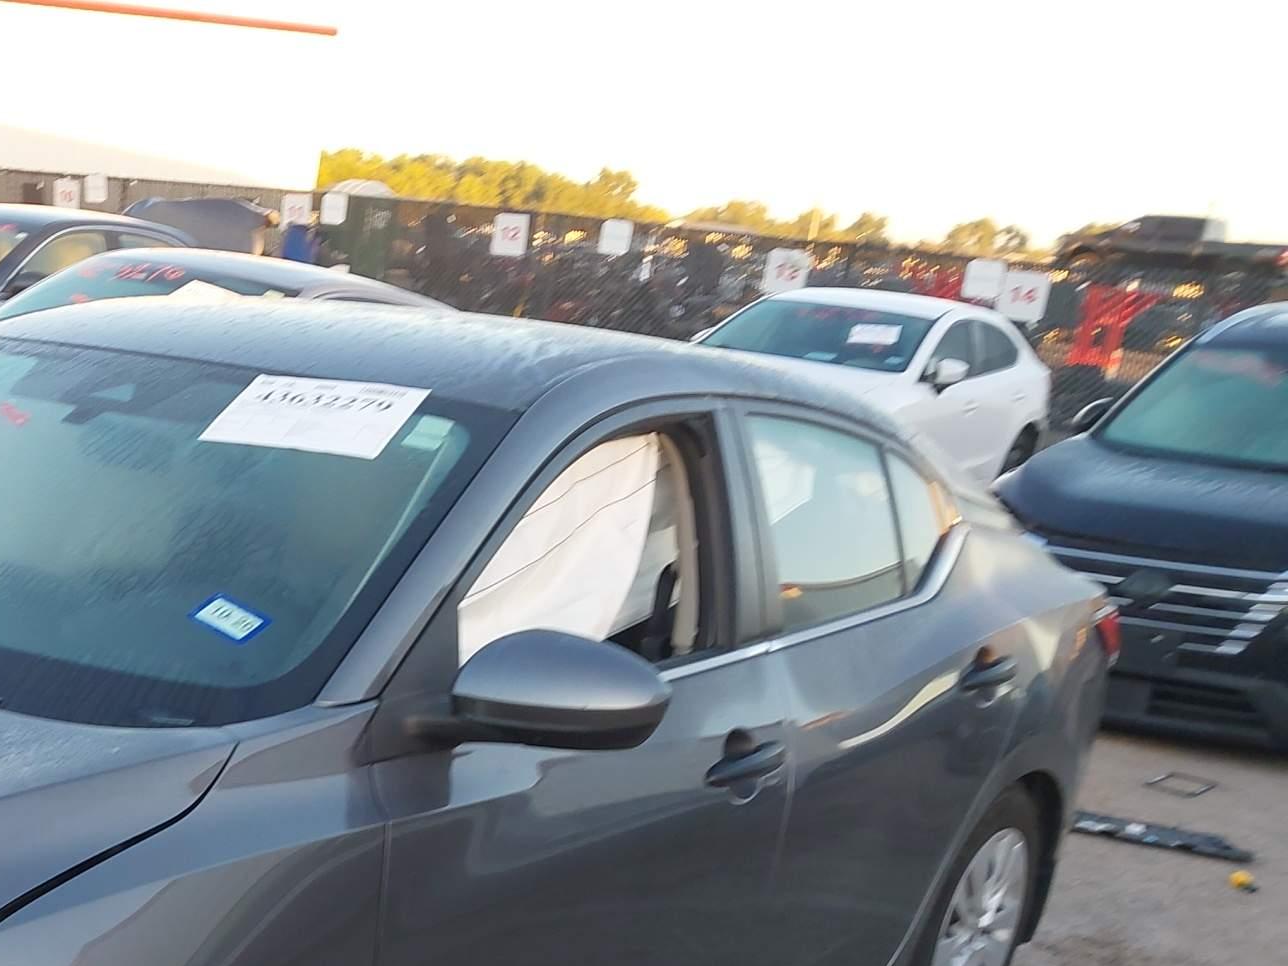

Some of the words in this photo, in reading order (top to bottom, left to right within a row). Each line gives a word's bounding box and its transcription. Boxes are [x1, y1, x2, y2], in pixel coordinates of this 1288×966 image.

[501, 225, 521, 241] 12
[1010, 285, 1037, 304] 14
[257, 390, 393, 413] 43632279
